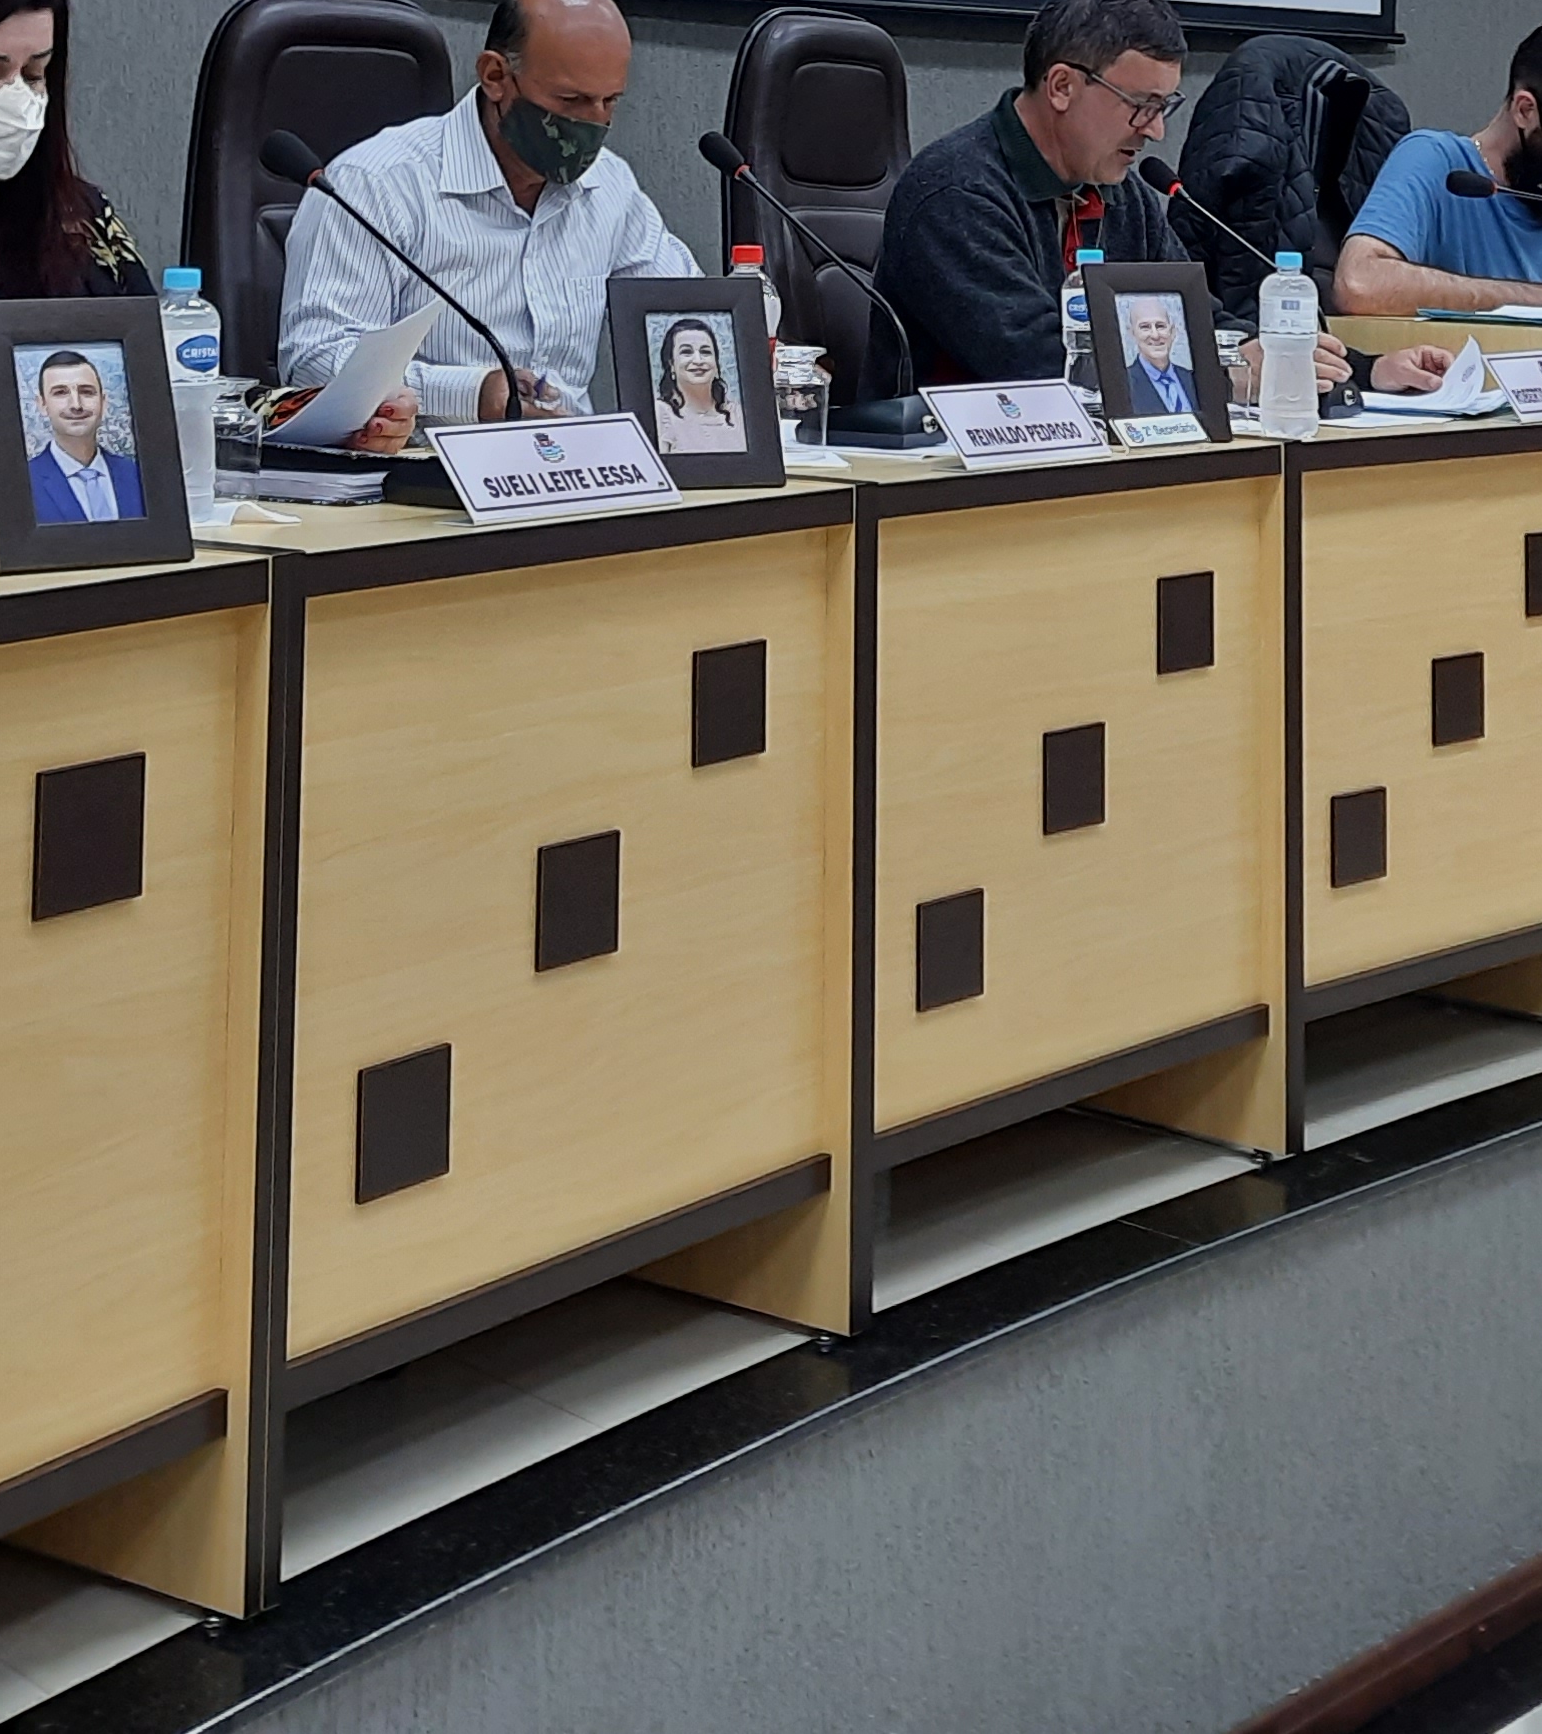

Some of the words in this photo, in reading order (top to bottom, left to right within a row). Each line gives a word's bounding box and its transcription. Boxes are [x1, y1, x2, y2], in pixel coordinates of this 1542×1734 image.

[181, 348, 217, 359] CRISTA
[965, 425, 1029, 448] REINALDO
[1024, 421, 1084, 444] PEDROSO
[482, 472, 540, 499] SUELI
[539, 467, 592, 493] LEITE
[589, 463, 648, 488] LESSA
